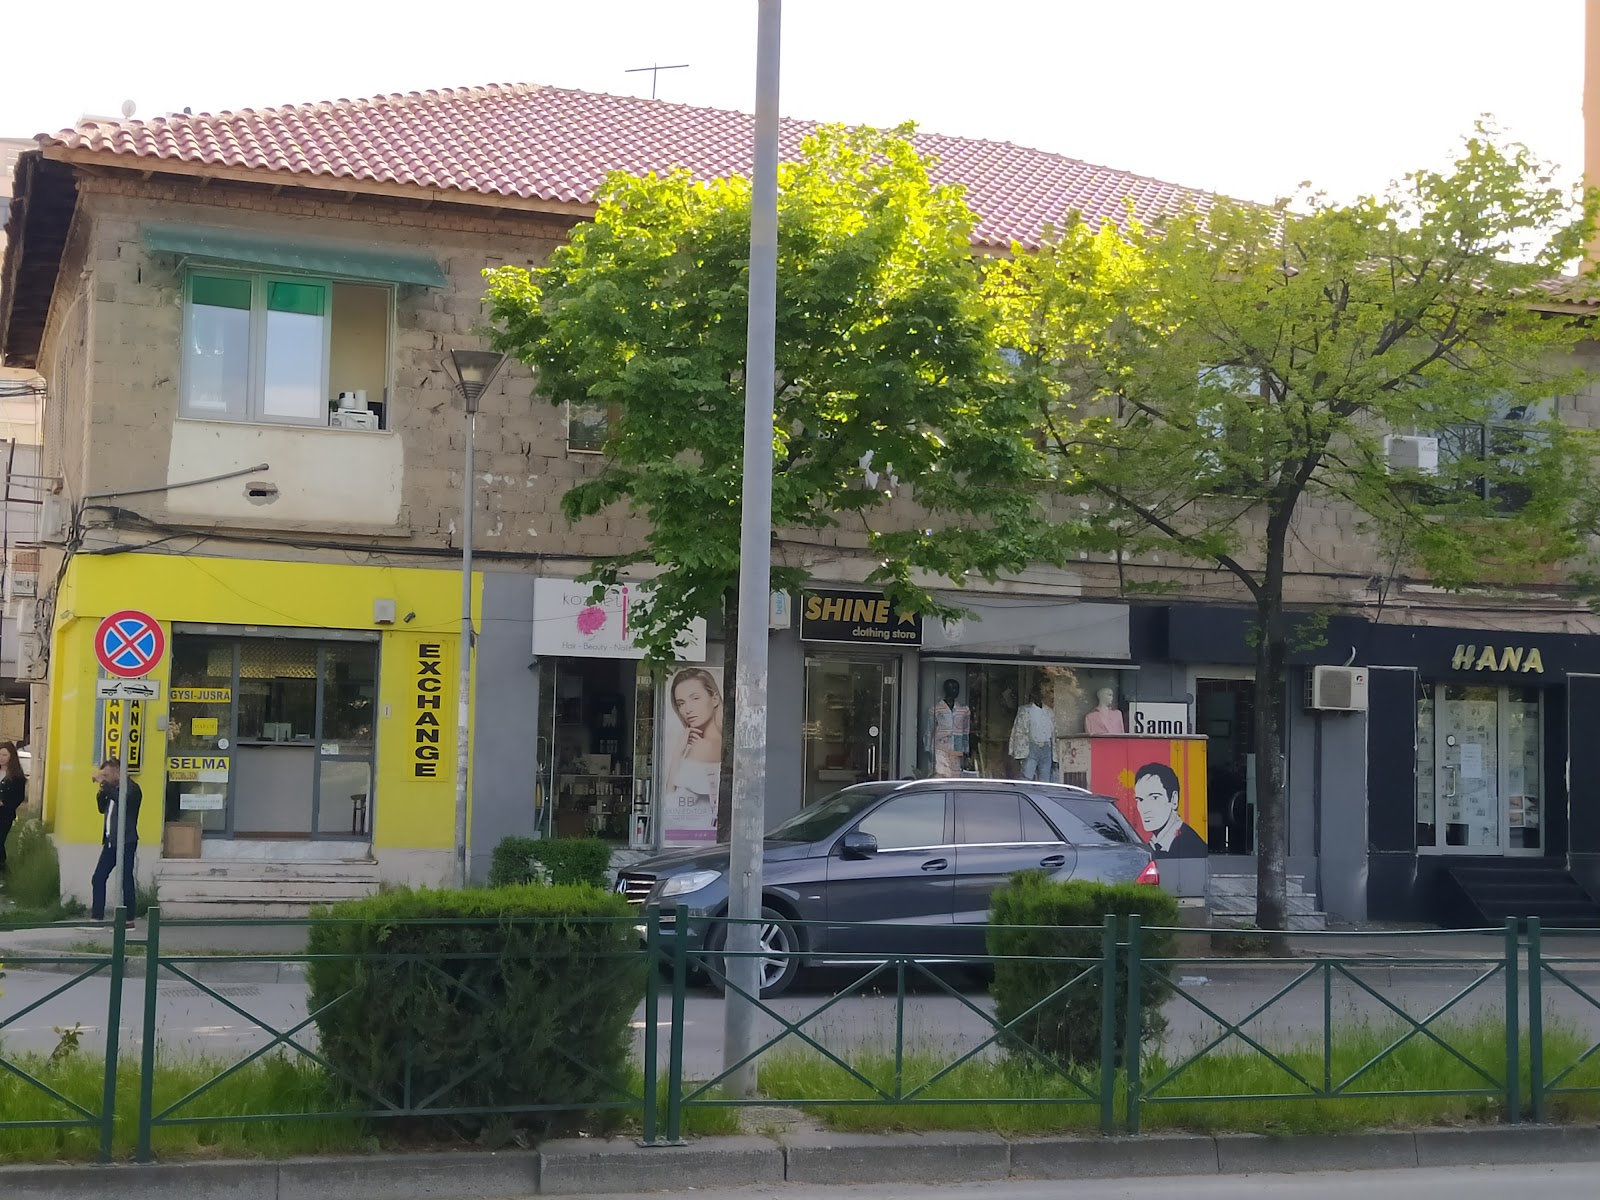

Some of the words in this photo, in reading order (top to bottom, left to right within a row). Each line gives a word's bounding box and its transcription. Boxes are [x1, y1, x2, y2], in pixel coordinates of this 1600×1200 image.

[775, 592, 783, 615] beko
[805, 596, 890, 623] SHINE
[852, 626, 890, 640] clothing
[892, 630, 916, 639] store
[562, 641, 577, 650] Hair
[583, 642, 608, 653] Beauty
[1451, 644, 1545, 674] HANA
[170, 690, 230, 700] GYSI-JUSRA
[415, 643, 442, 777] EXCHANGE
[1133, 711, 1183, 735] Samo
[170, 758, 227, 770] SELMA
[678, 796, 695, 807] BB
